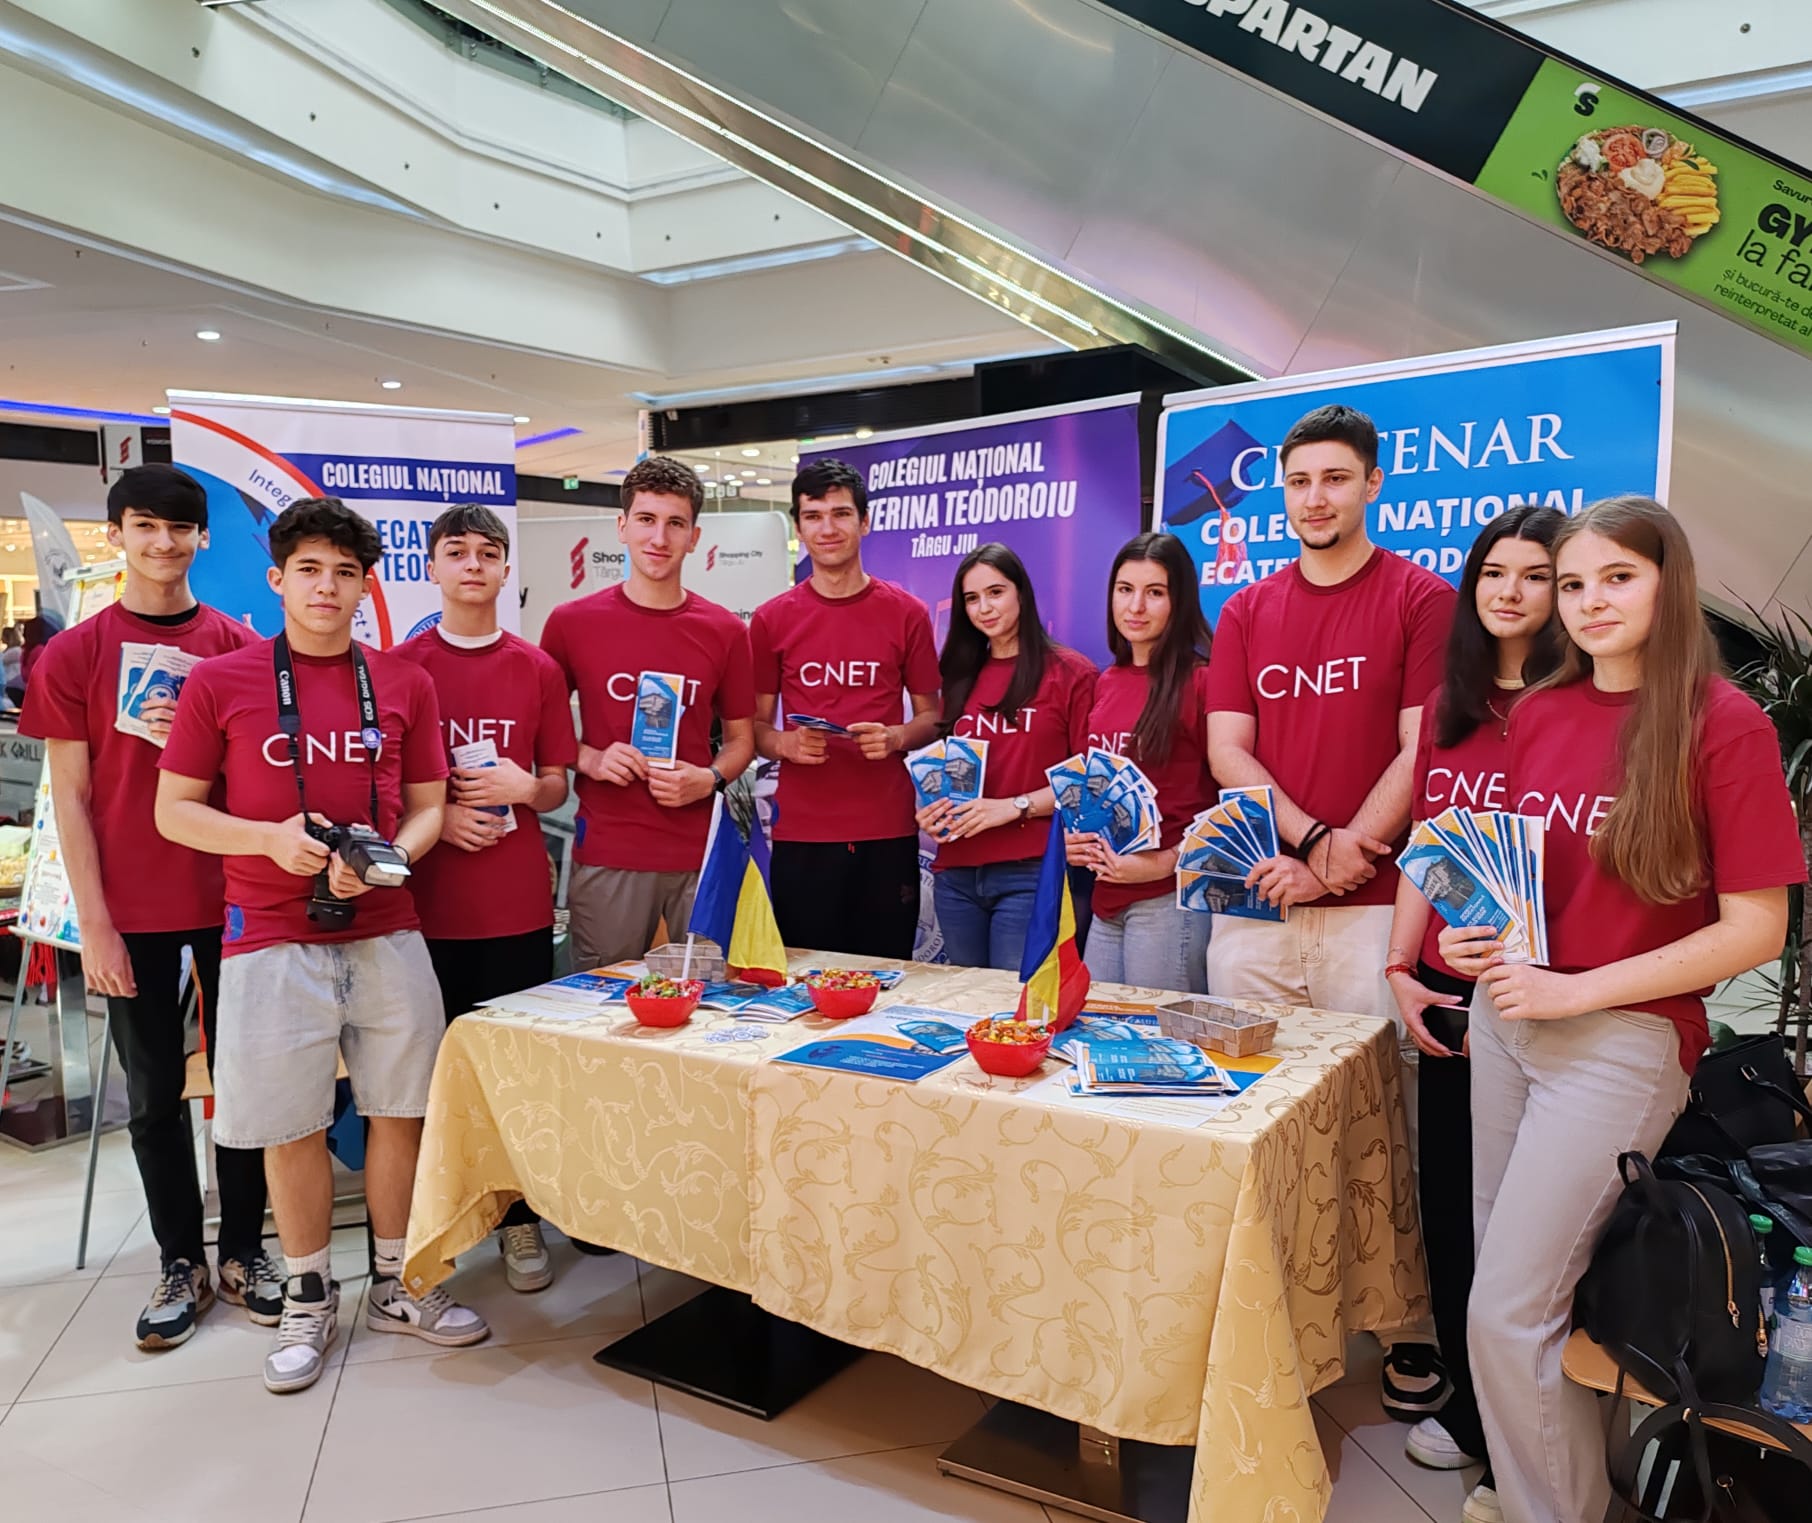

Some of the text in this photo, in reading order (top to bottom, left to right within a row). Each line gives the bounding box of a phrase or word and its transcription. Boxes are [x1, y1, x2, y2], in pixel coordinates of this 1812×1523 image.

[1184, 0, 1439, 113] ARTAN
[1772, 179, 1812, 205] Savur
[1757, 202, 1812, 253] GY
[1736, 228, 1812, 292] la fa
[1713, 283, 1797, 332] reinterpretat
[1735, 270, 1800, 313] bucură-te
[867, 441, 1045, 492] COLEGIUL NAȚIONAL
[1230, 413, 1574, 492] CENAR
[248, 468, 292, 508] Integ
[322, 462, 506, 502] COLEGIUL NAȚIONAL
[867, 480, 1078, 532] TERINA TEODOROIU
[375, 519, 433, 550] ECAT
[911, 533, 978, 558] TÂRGU JIU
[383, 553, 432, 582] TEO
[592, 552, 626, 565] Shop
[279, 670, 292, 706] Canon
[606, 672, 702, 706] CT
[799, 660, 881, 687] CNET
[1256, 656, 1367, 699] CNET
[363, 700, 375, 721] EOS
[439, 718, 517, 748] NET
[1425, 767, 1506, 809] CNE
[1517, 791, 1620, 836] CNE
